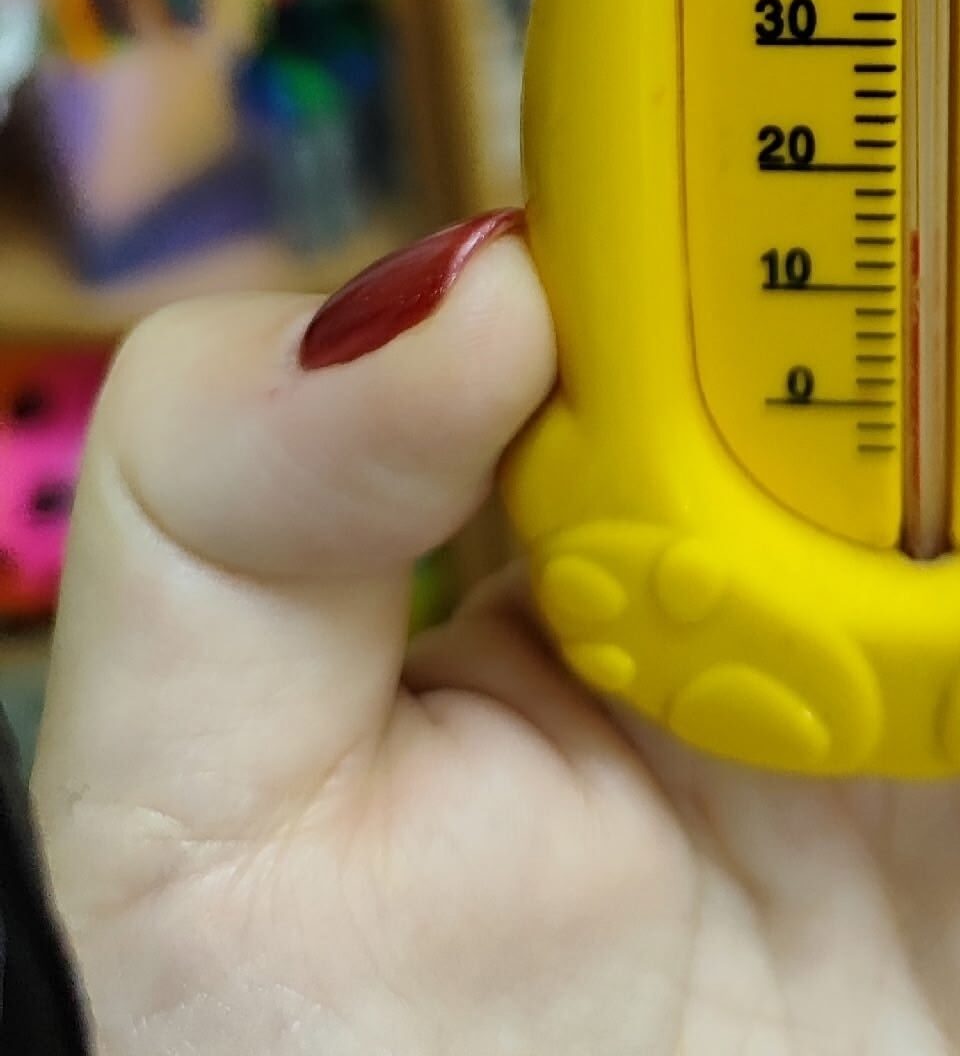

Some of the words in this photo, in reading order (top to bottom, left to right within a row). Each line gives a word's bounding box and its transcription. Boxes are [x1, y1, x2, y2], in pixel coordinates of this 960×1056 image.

[757, 125, 816, 164] 20
[760, 248, 812, 287] 10
[786, 366, 815, 401] 0
